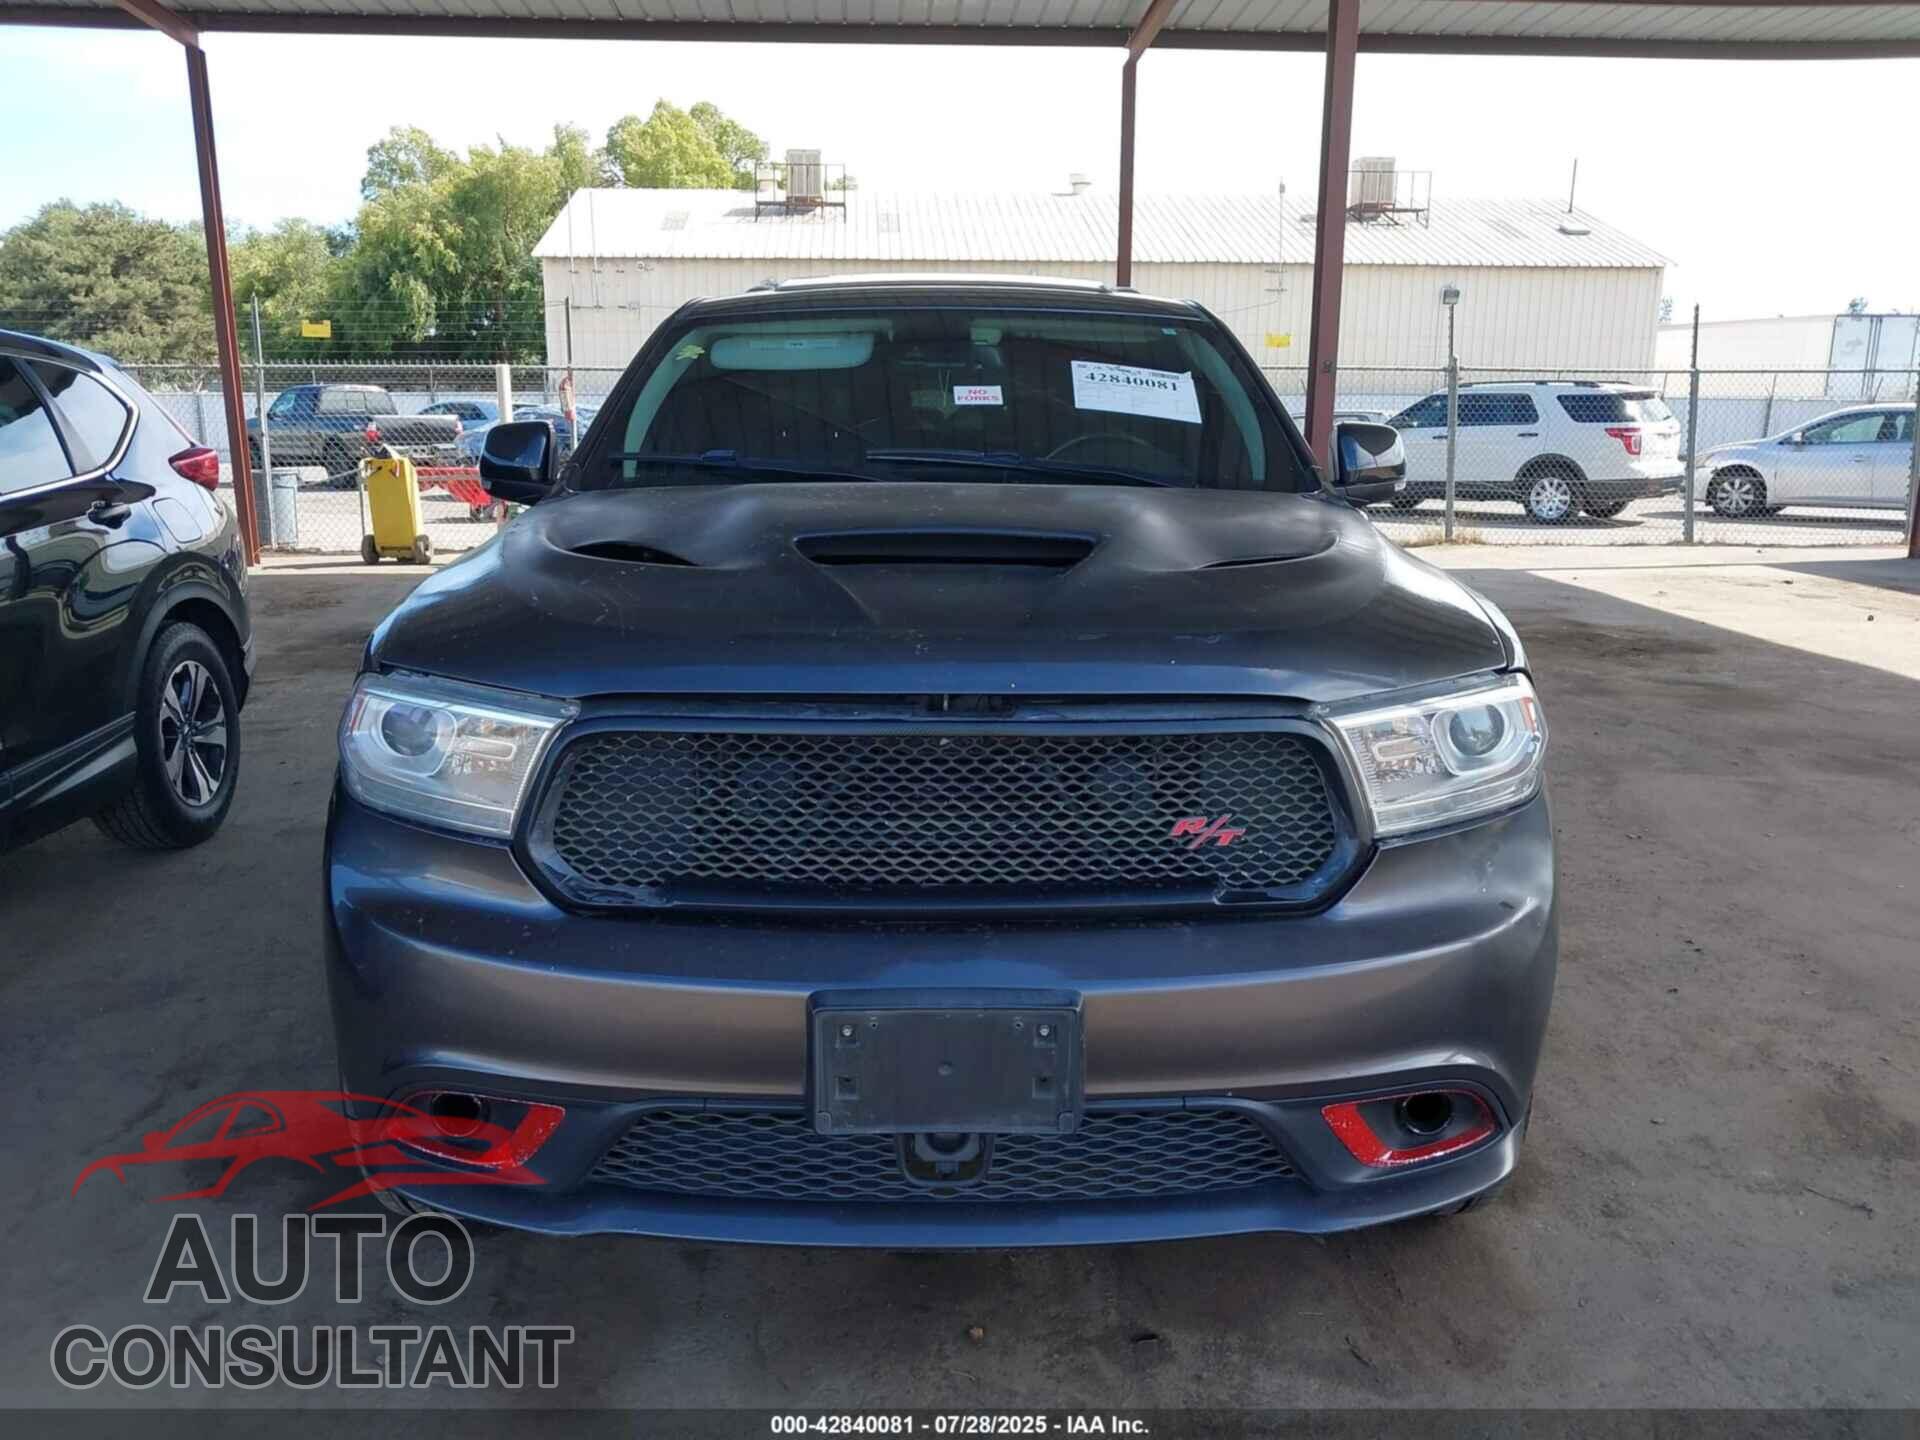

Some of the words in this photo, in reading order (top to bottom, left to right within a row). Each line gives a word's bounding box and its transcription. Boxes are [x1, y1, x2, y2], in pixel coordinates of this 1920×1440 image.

[967, 388, 988, 396] NO
[1085, 371, 1178, 392] 42840081
[1169, 812, 1247, 850] R/T
